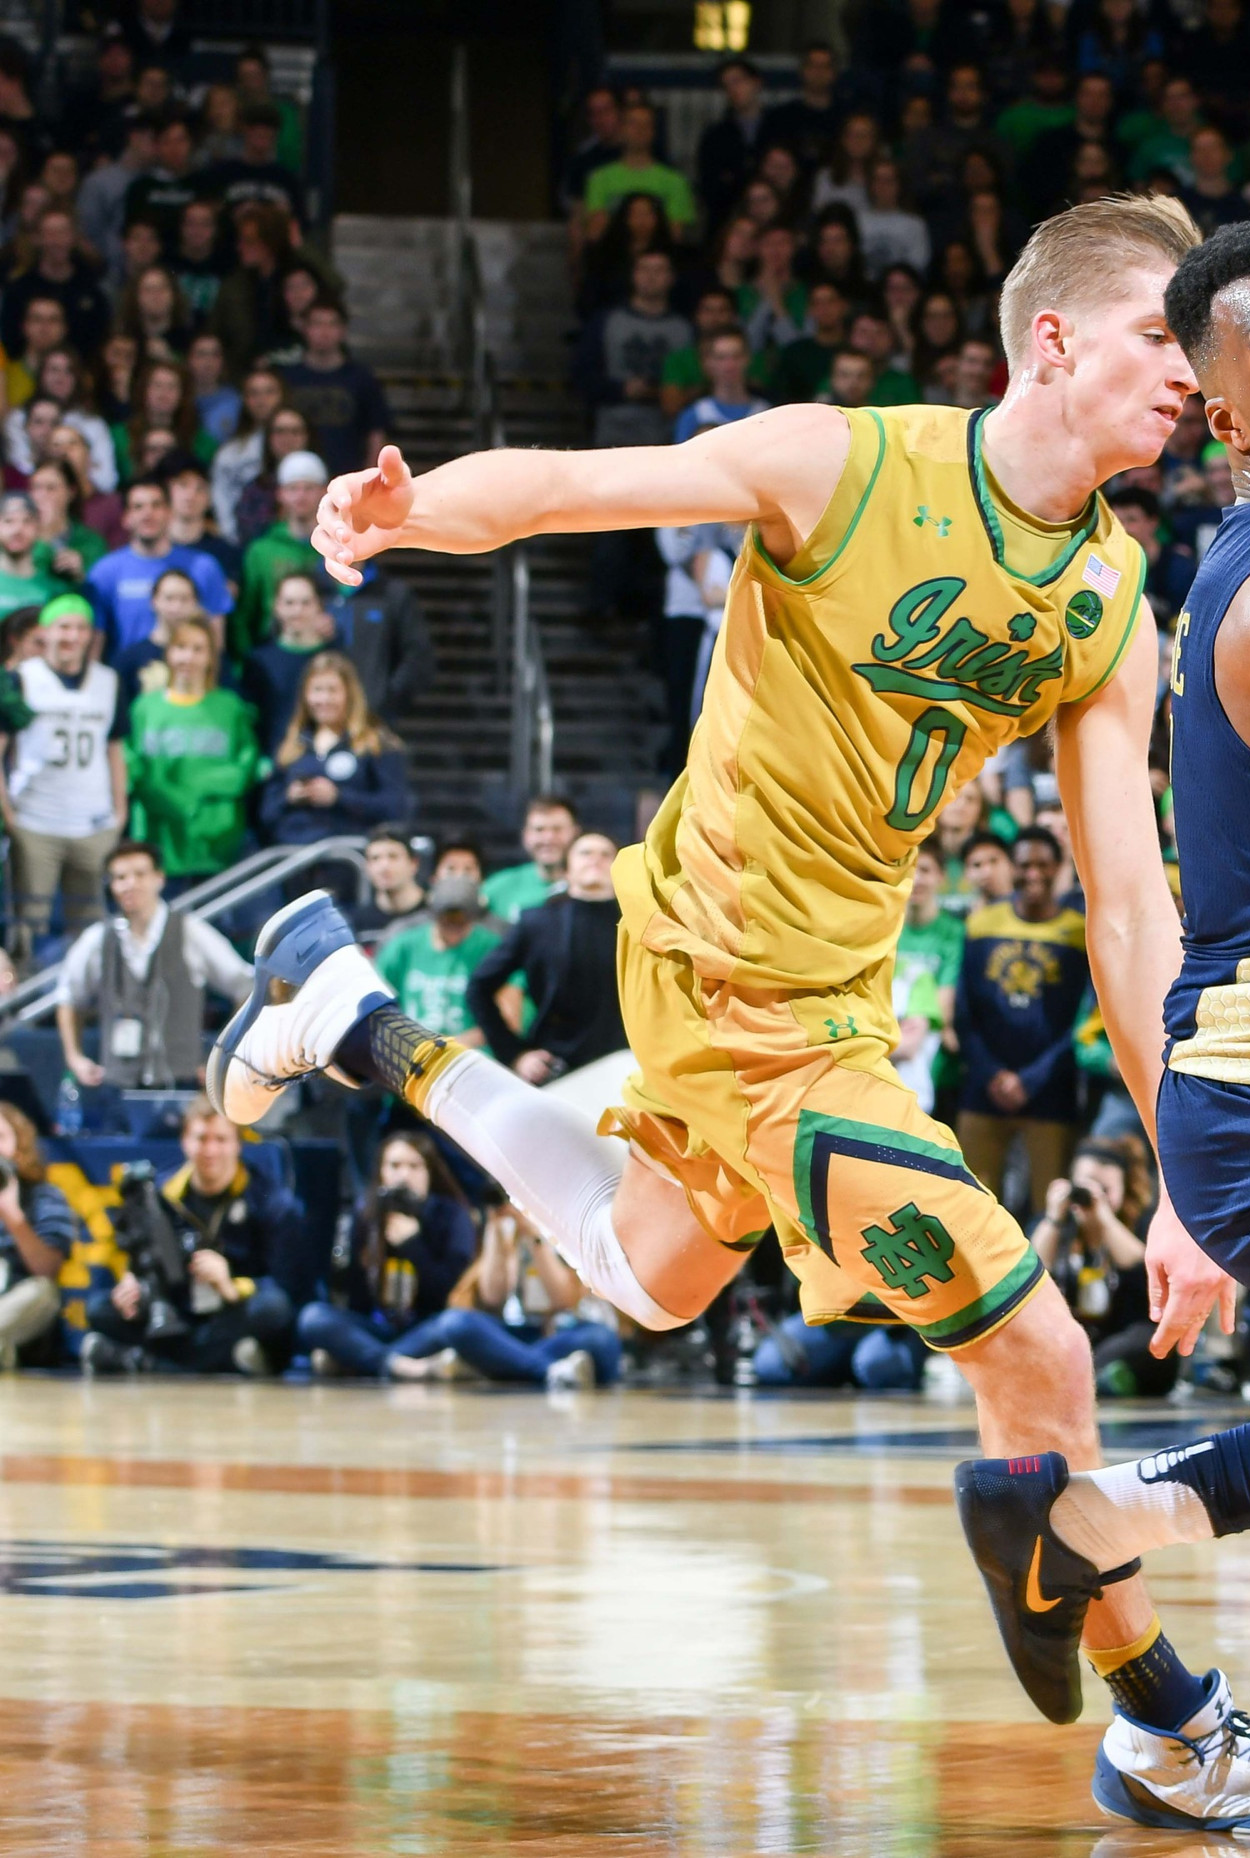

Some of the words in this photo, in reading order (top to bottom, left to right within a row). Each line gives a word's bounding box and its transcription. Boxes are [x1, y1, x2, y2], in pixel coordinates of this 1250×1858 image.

[872, 576, 1063, 702] Irish
[47, 728, 94, 768] 30
[884, 706, 967, 831] 0
[860, 1201, 955, 1299] ND
